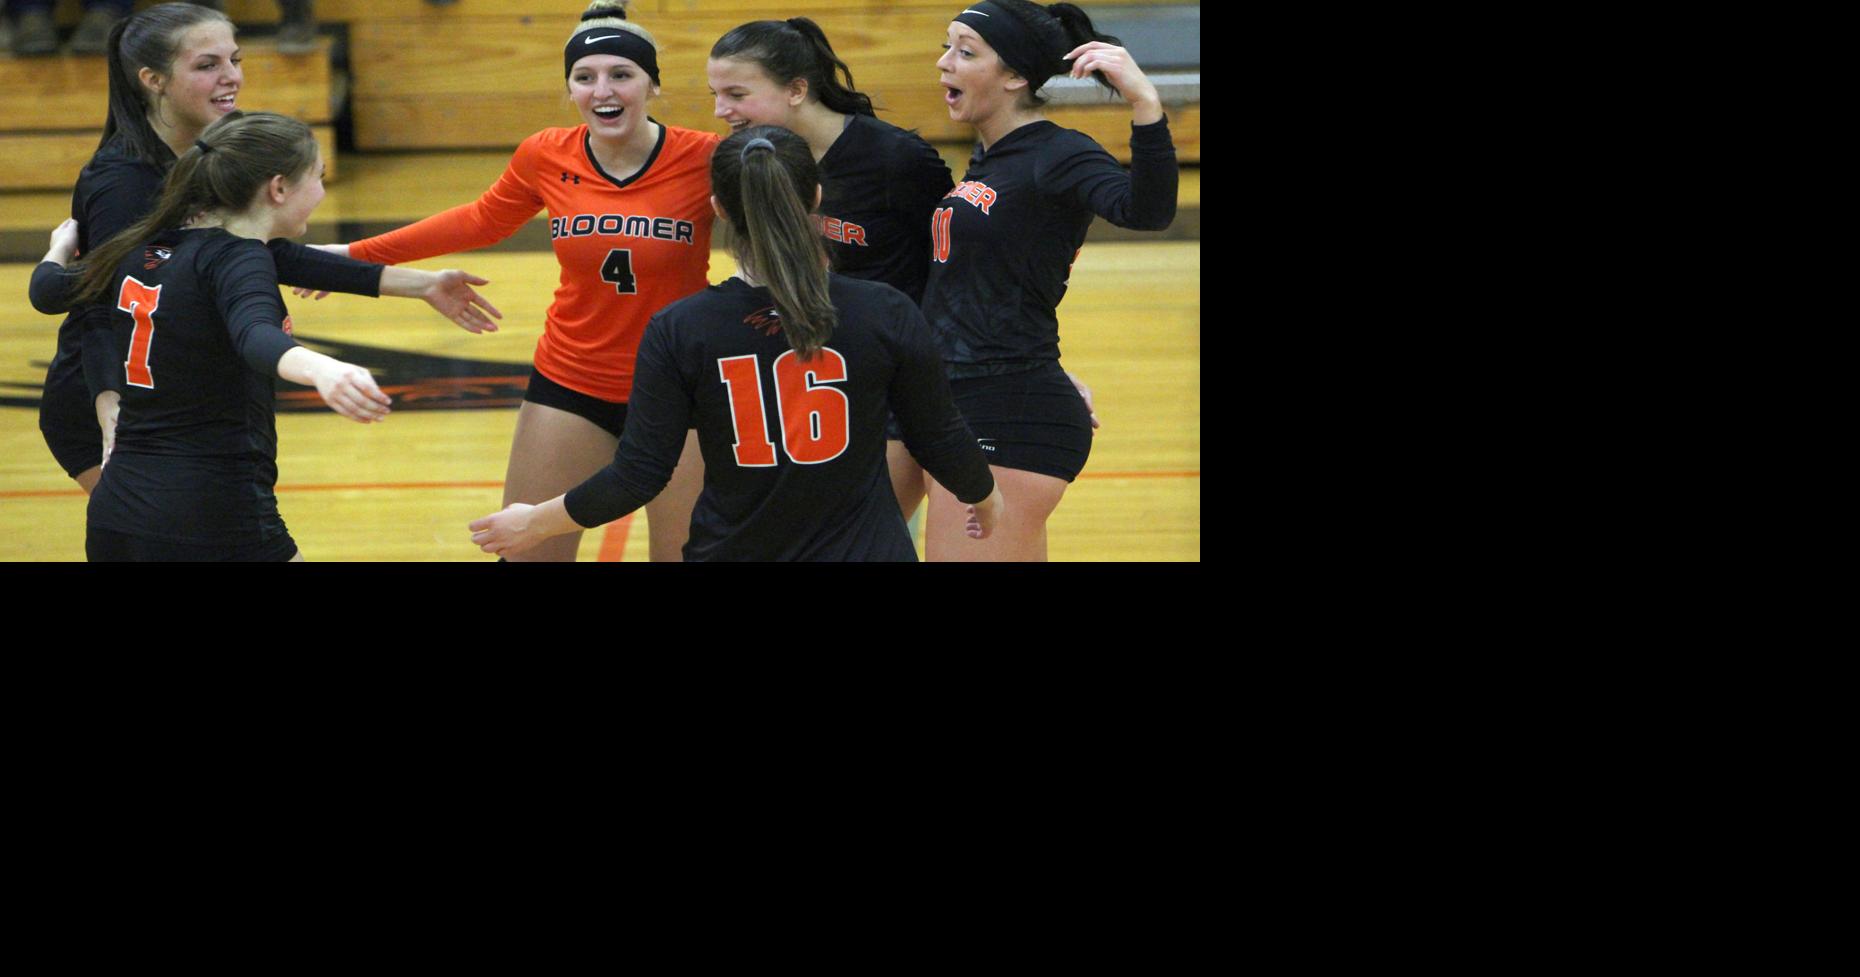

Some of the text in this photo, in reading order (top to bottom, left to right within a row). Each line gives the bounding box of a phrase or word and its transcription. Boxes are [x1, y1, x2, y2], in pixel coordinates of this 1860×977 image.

[551, 213, 694, 245] BLOOMER
[932, 207, 953, 263] 10
[600, 248, 637, 295] 4
[118, 275, 162, 389] 7
[717, 346, 849, 467] 16
